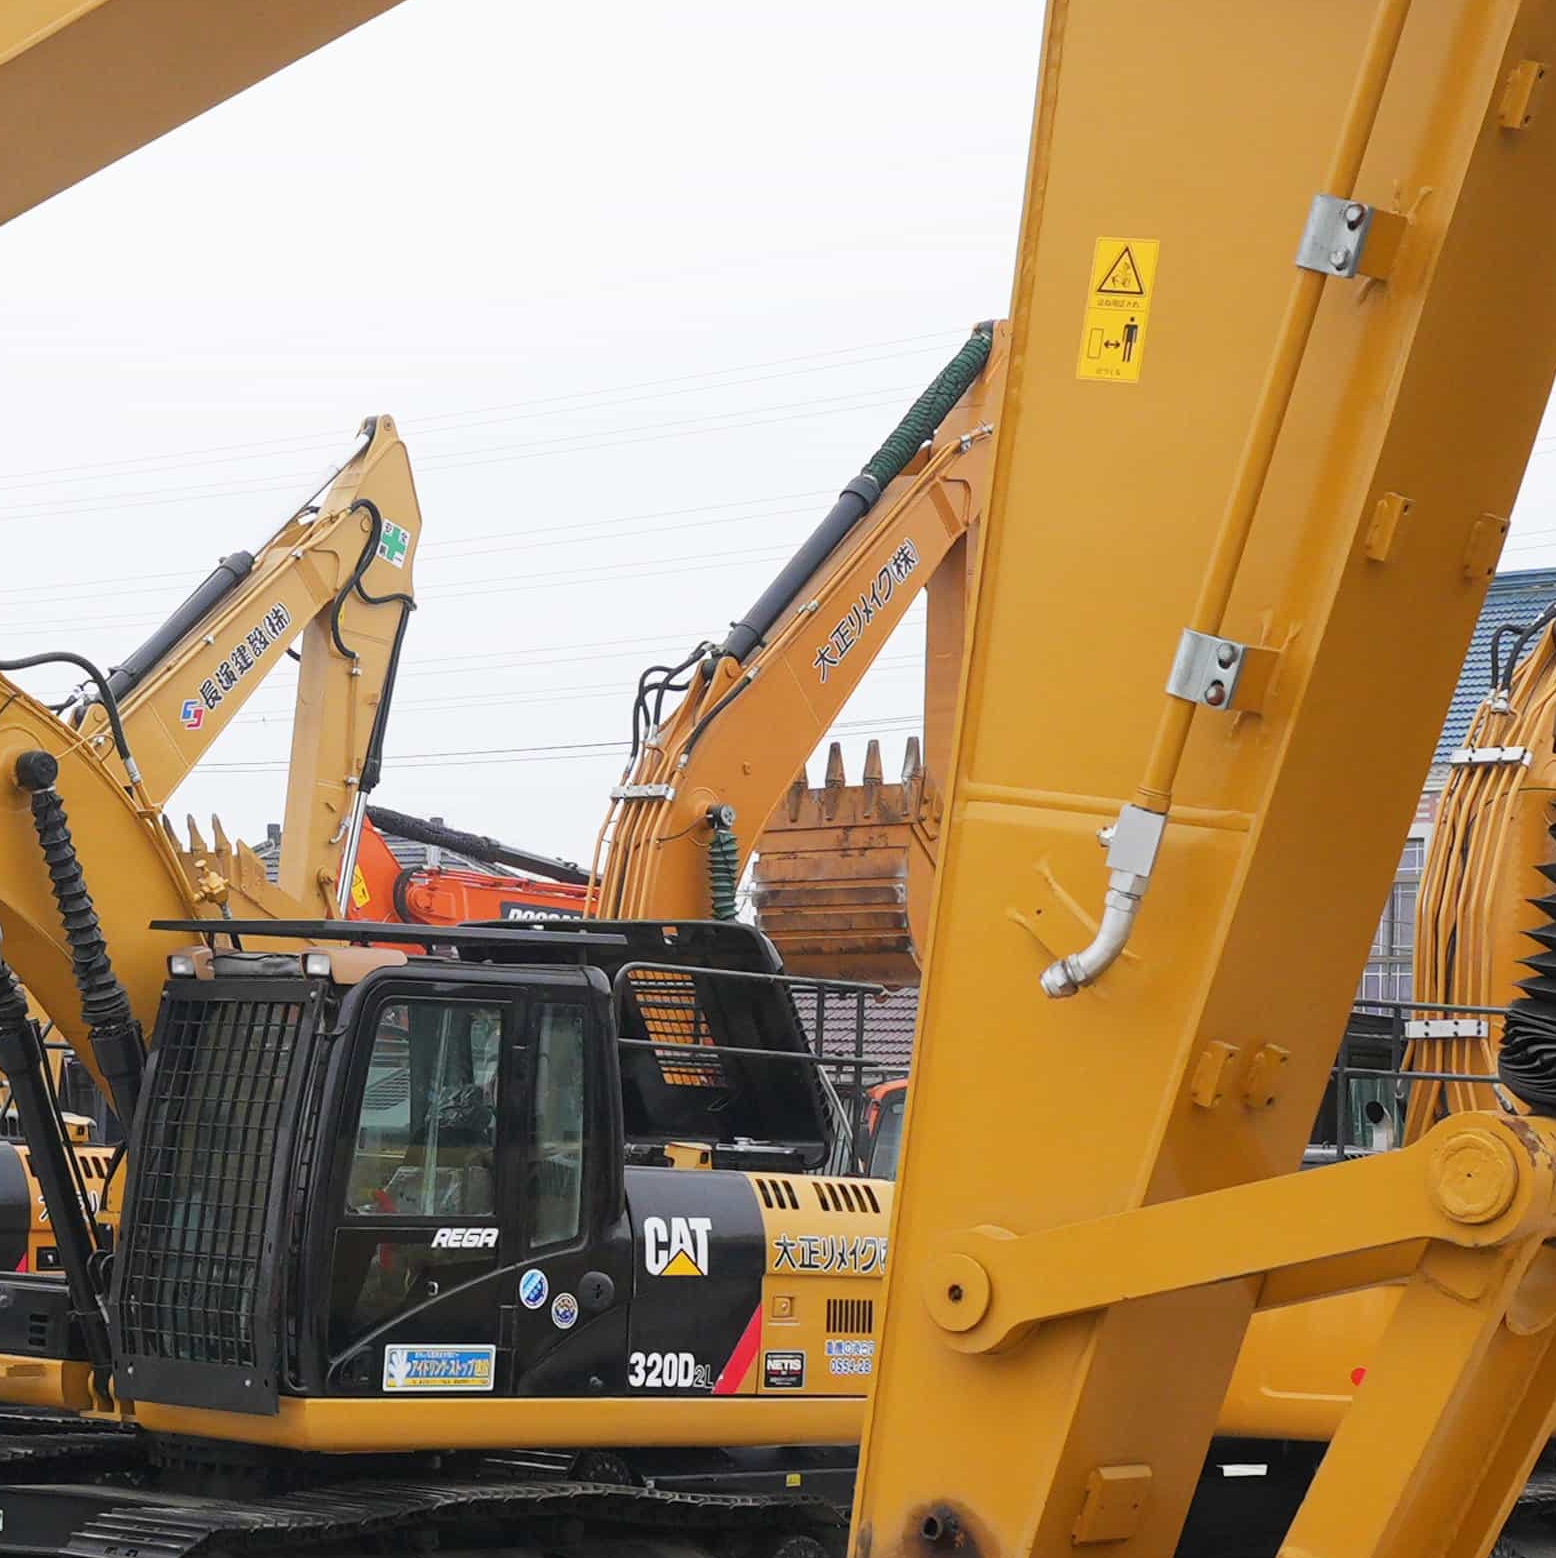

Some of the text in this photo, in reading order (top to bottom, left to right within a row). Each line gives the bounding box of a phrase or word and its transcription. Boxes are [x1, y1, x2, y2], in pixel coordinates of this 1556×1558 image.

[813, 538, 920, 683] 大正リメイク(株)
[644, 1217, 712, 1276] CAT
[767, 1359, 802, 1371] NETIS
